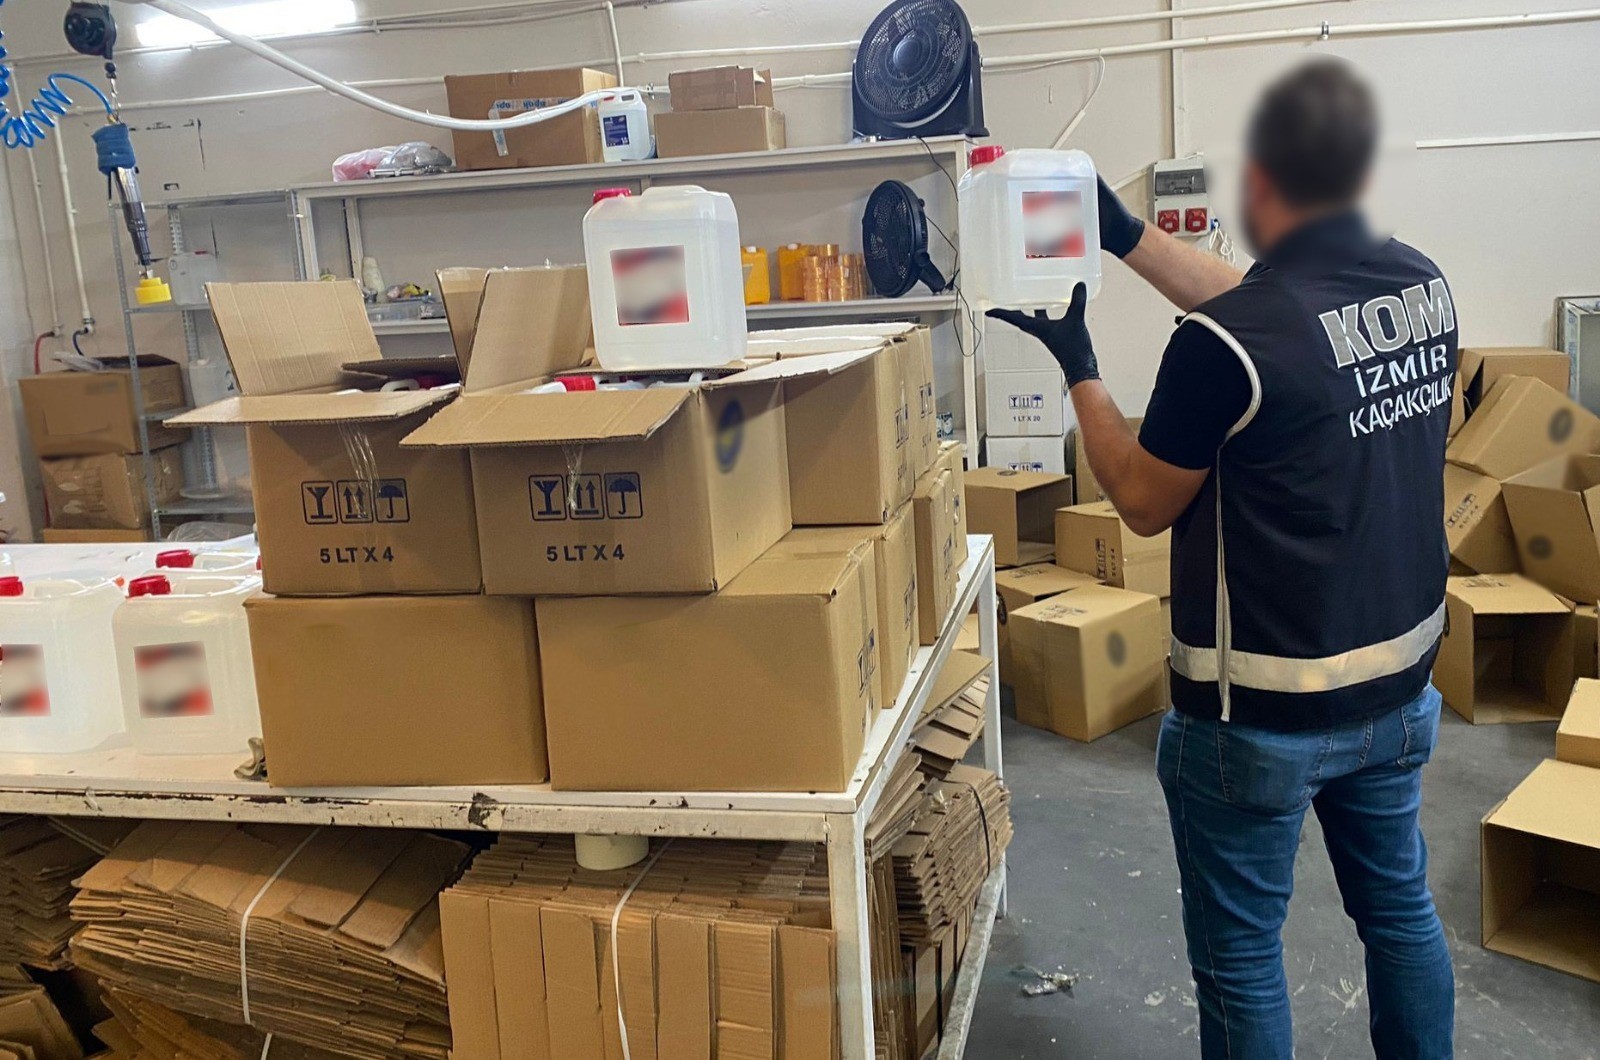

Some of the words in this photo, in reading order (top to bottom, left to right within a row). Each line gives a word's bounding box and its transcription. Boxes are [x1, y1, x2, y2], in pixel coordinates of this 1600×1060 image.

[1318, 278, 1455, 369] KOM
[1354, 345, 1447, 398] İZMİR
[1349, 372, 1454, 438] KAÇAKÇILIK
[320, 547, 331, 564] 5
[335, 546, 358, 564] LT
[362, 546, 379, 563] X
[382, 546, 394, 562] 4
[546, 546, 558, 562] 5
[563, 545, 587, 562] LT
[592, 544, 608, 561] X
[612, 543, 625, 560] 4
